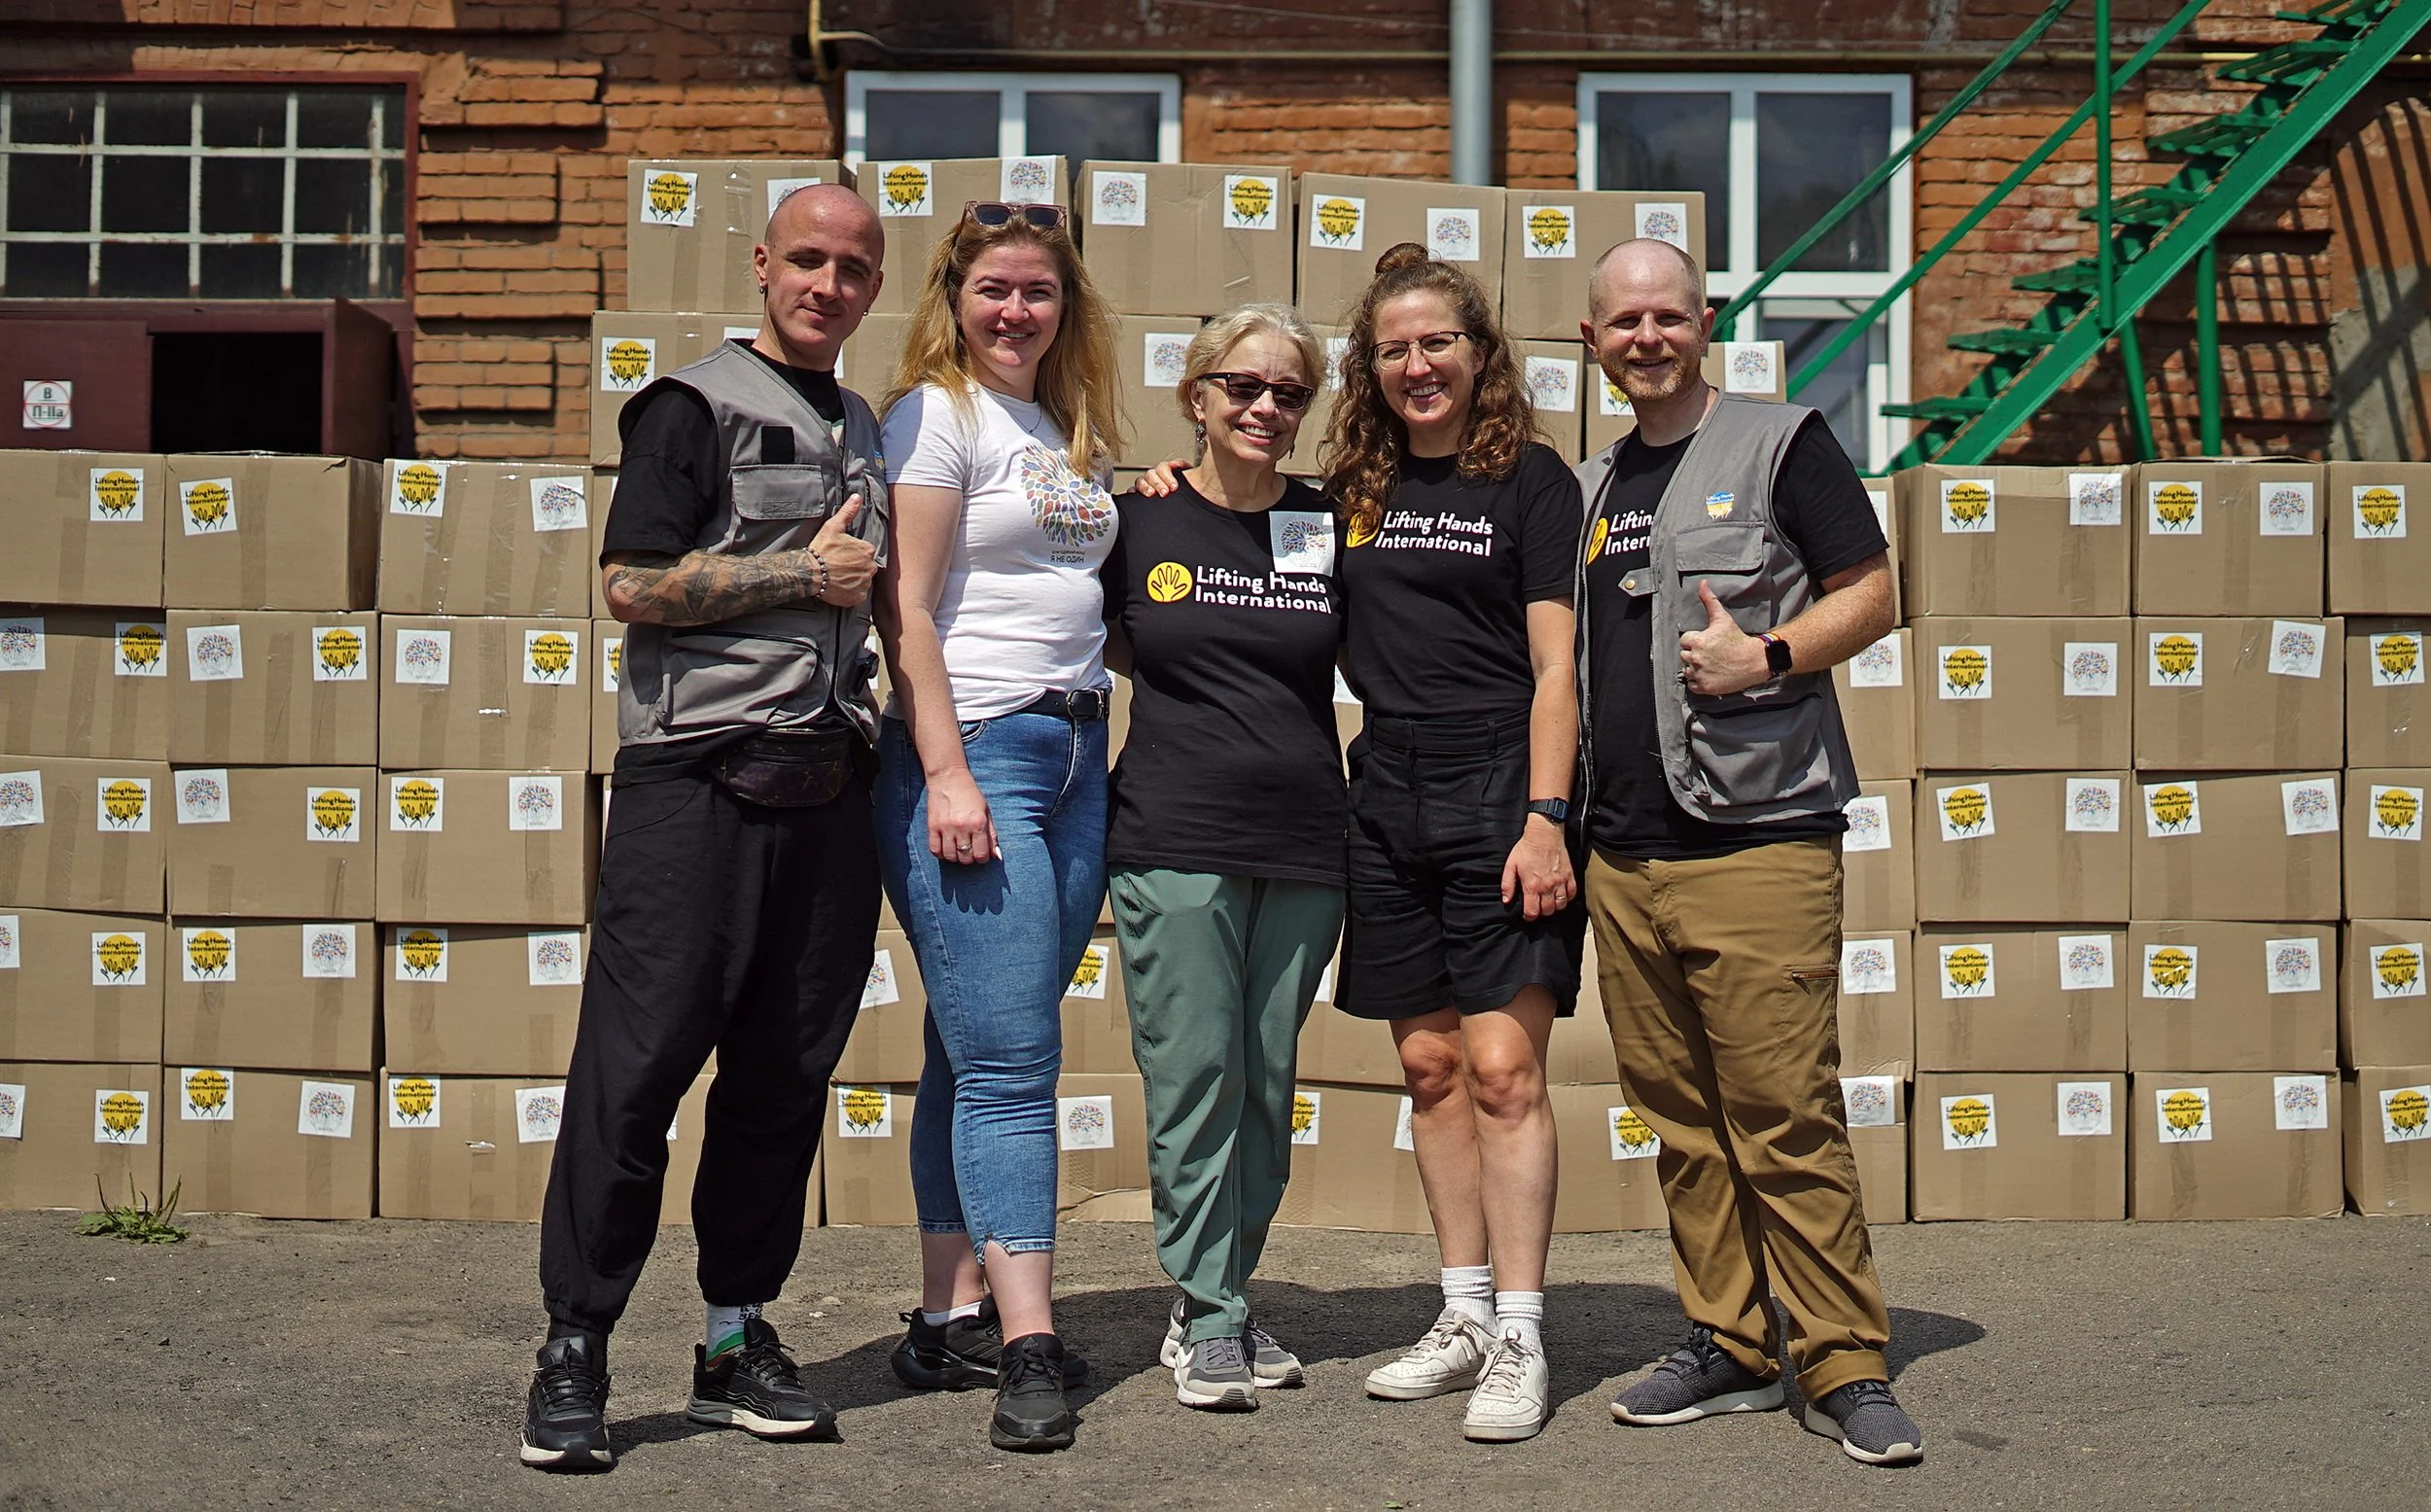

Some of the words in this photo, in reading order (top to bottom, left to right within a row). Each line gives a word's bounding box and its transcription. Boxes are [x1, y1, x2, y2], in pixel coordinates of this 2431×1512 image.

[883, 172, 906, 181] Lifting
[648, 179, 671, 189] Lifting
[671, 180, 692, 189] Hands
[647, 186, 692, 195] International
[1229, 185, 1251, 193] Lifting
[1317, 203, 1339, 214] Lifting
[1339, 205, 1359, 214] Hands
[1317, 211, 1360, 220] International
[607, 347, 629, 356] Lifting
[44, 387, 53, 399] В
[398, 470, 421, 479] Lifting
[420, 471, 441, 479] Hands
[95, 477, 118, 486] Lifting
[397, 477, 441, 486] International
[185, 489, 208, 498] Lifting
[207, 486, 229, 496] Hands
[1946, 488, 1969, 497] Lifting
[2153, 490, 2176, 499] Lifting
[186, 494, 229, 506] International
[2357, 494, 2379, 503] Lifting
[1383, 510, 1434, 535] Lifting
[1437, 511, 1493, 535] Hands
[1610, 510, 1653, 533] Liftin
[1375, 531, 1492, 556] International
[1196, 565, 1264, 594] Lifting
[1269, 571, 1326, 594] Hands
[1195, 584, 1331, 614] International
[120, 631, 142, 640] Lifting
[317, 636, 340, 645] Lifting
[529, 640, 552, 649] Lifting
[2154, 642, 2176, 651] Lifting
[2375, 648, 2419, 657] International
[396, 787, 418, 795] Lifting
[2171, 790, 2193, 799] Hands
[311, 796, 335, 805] Lifting
[1942, 794, 1965, 804] Lifting
[1964, 791, 1986, 801] Hands
[2375, 794, 2398, 804] Lifting
[1943, 798, 1988, 811] International
[2149, 797, 2195, 808] International
[187, 937, 210, 946] Lifting
[401, 935, 423, 945] Lifting
[96, 941, 120, 950] Lifting
[1944, 954, 1967, 963] Lifting
[1967, 952, 1989, 961] Hands
[2149, 954, 2171, 963] Lifting
[2398, 951, 2419, 961] Hands
[1945, 960, 1990, 968] International
[2376, 959, 2420, 969] International
[393, 1083, 414, 1092] Lifting
[100, 1099, 123, 1108] Lifting
[2184, 1096, 2204, 1105] Hands
[2384, 1097, 2408, 1106] Lifting
[2408, 1094, 2428, 1104] Hands
[1946, 1105, 1969, 1113] Lifting
[1968, 1103, 1990, 1111] Hands
[2162, 1104, 2205, 1112] International
[2385, 1102, 2430, 1113] International
[1946, 1110, 1991, 1120] International
